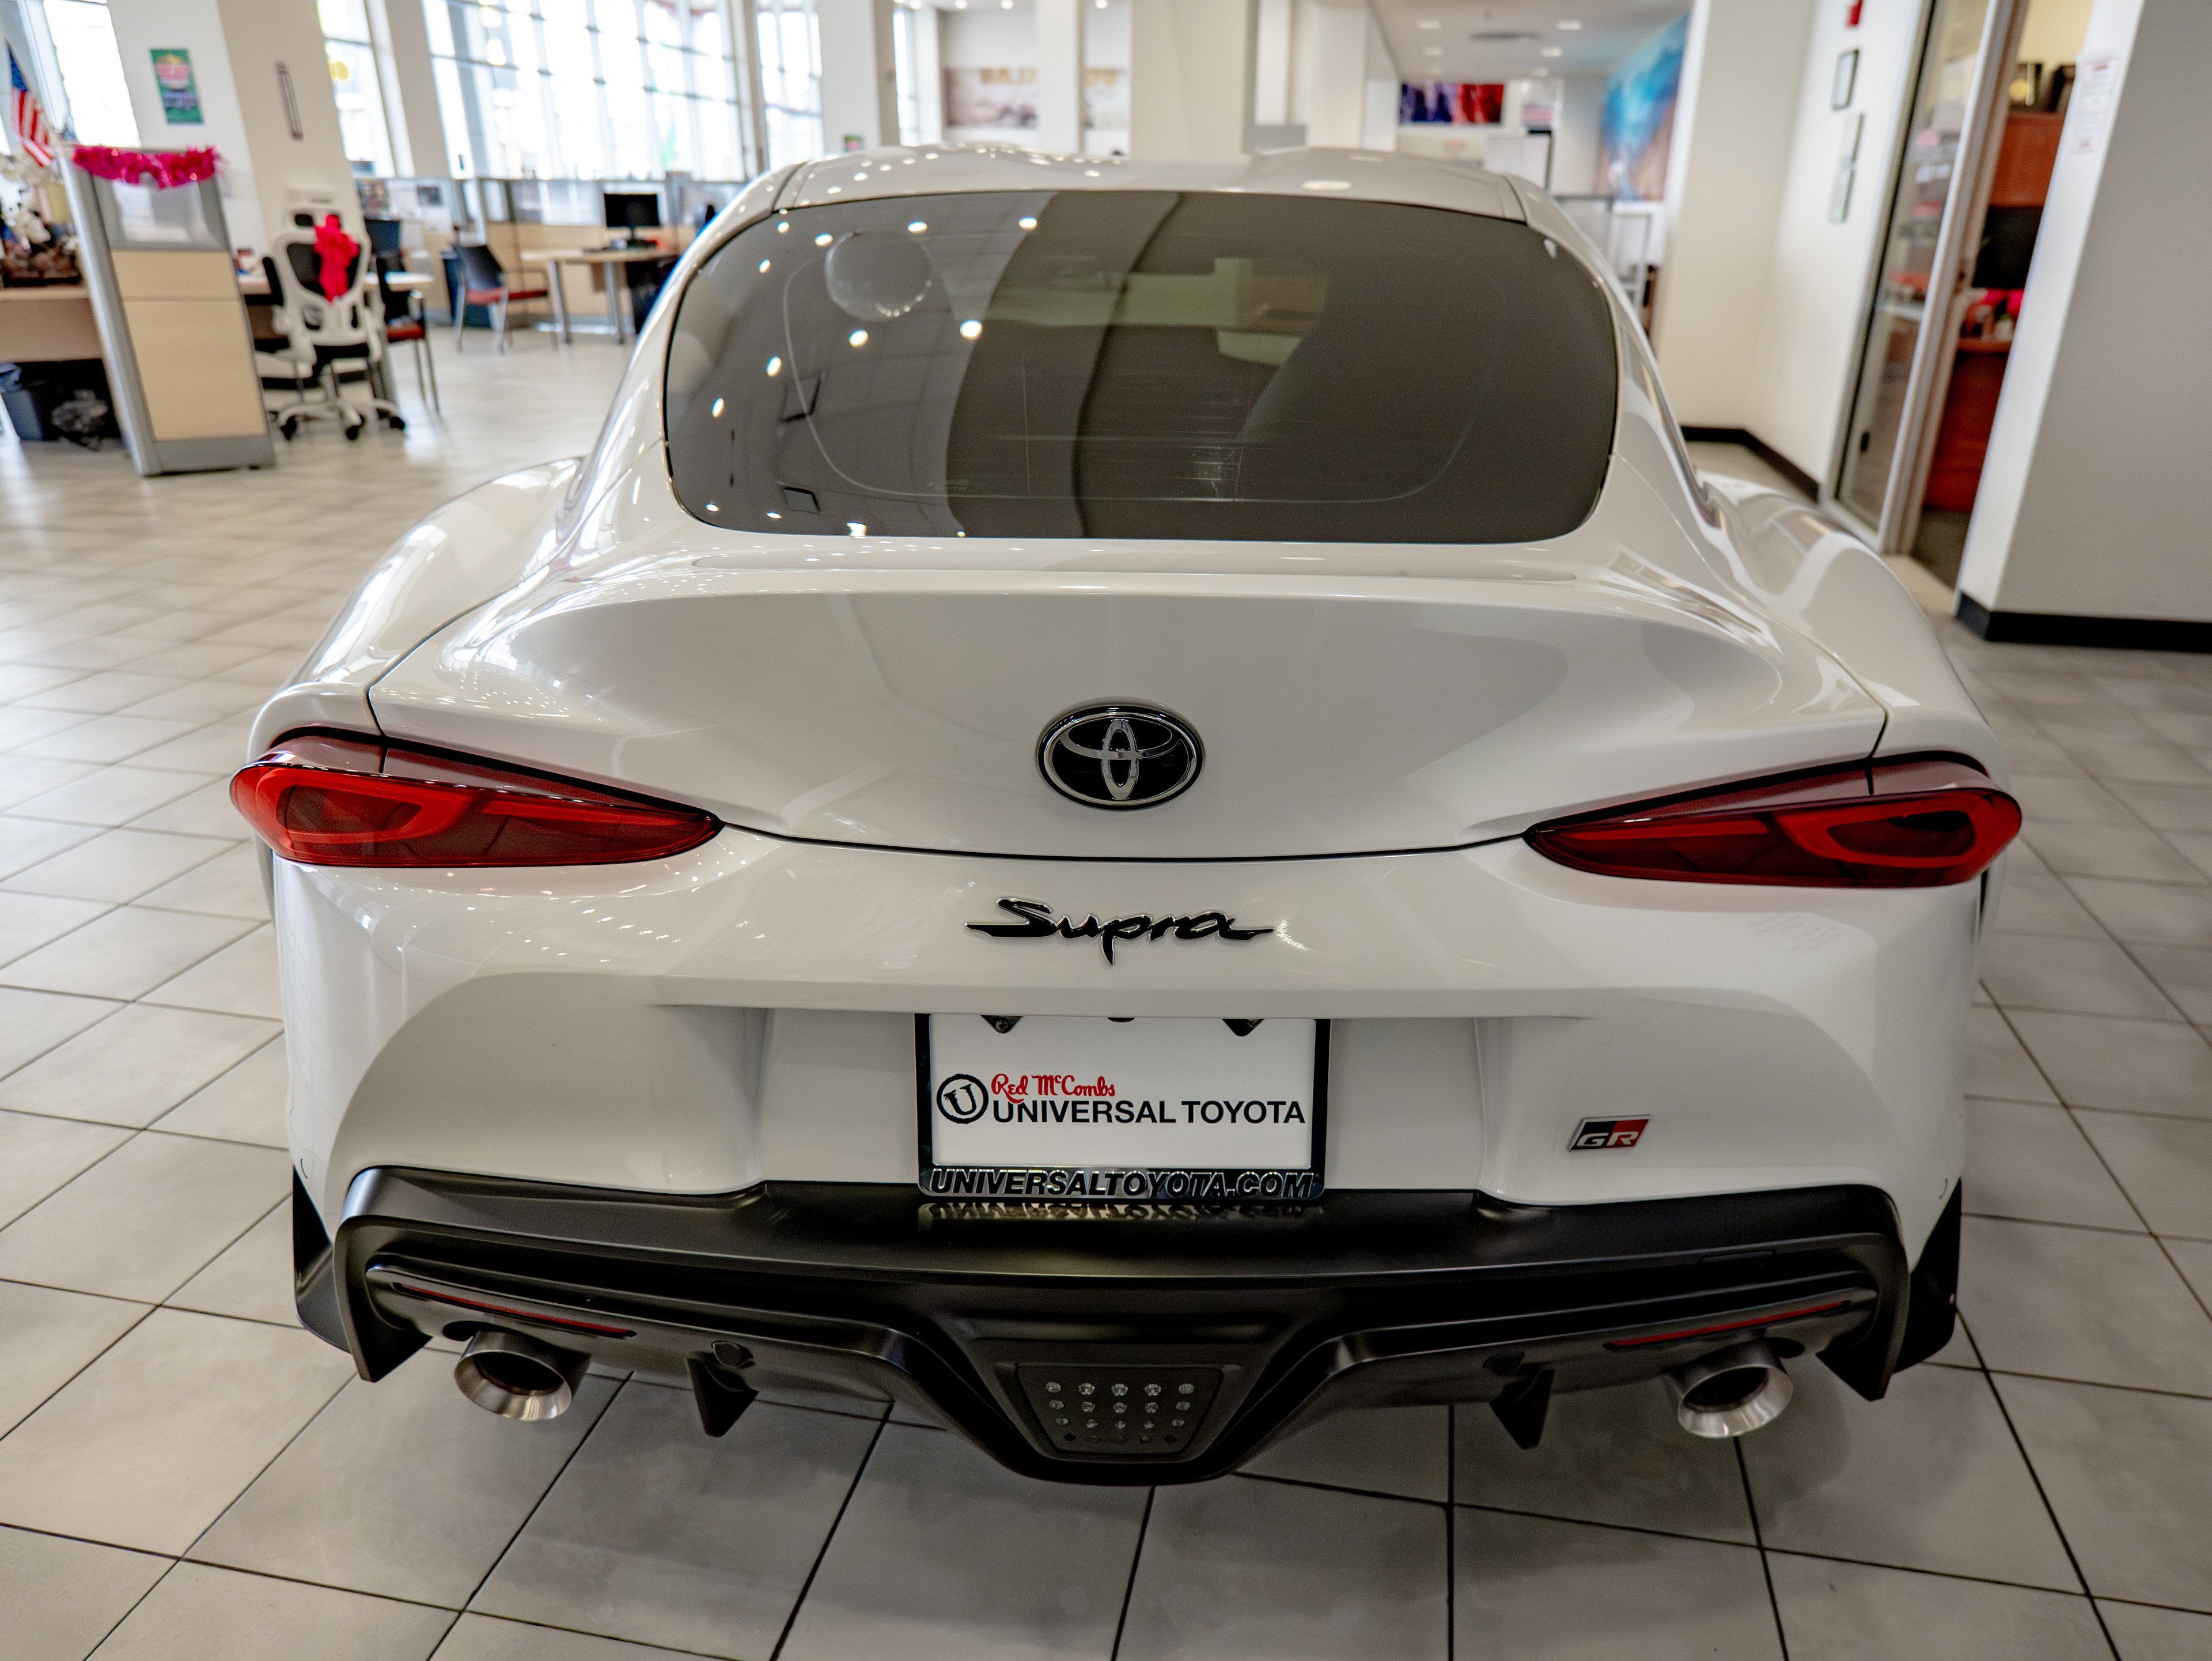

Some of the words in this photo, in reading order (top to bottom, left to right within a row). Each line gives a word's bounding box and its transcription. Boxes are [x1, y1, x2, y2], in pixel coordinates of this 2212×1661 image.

[965, 897, 1275, 965] Supra
[991, 1073, 1029, 1103] Red
[1032, 1074, 1115, 1096] McCombs
[993, 1100, 1176, 1123] UNIVERSAL
[1181, 1100, 1305, 1123] TOYOTA
[1577, 1131, 1639, 1147] GR
[930, 1168, 1315, 1197] UNIVERSALTOYOTA.COM
